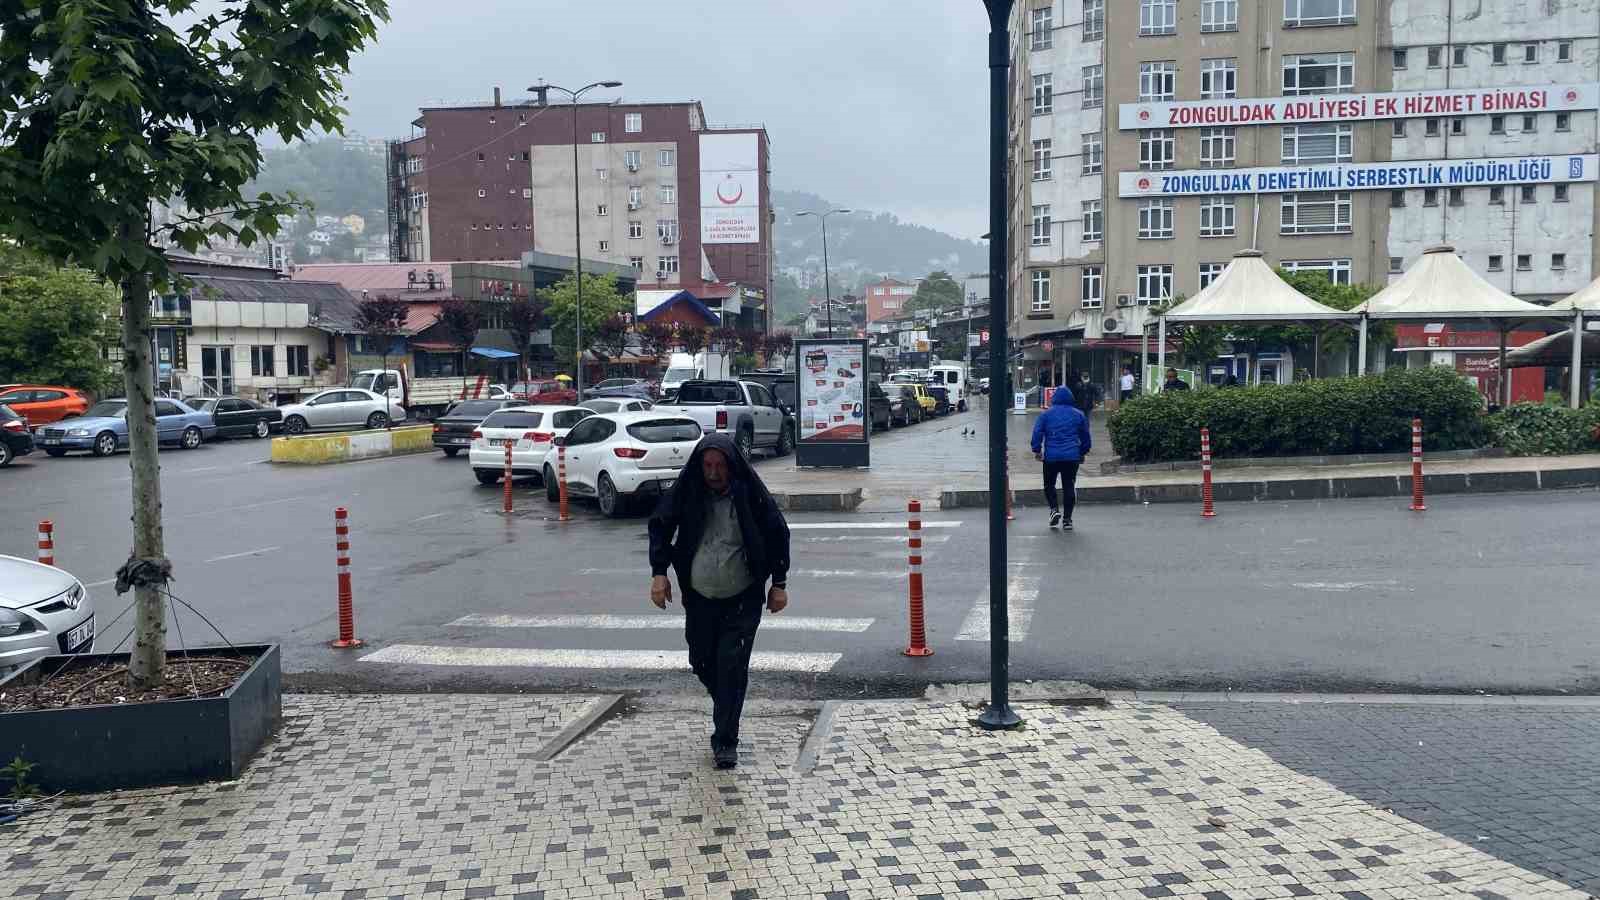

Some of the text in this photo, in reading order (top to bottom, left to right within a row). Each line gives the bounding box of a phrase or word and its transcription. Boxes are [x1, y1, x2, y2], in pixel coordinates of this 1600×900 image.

[1169, 88, 1547, 125] ZONGULDAK ADLİYESİ EK HİZMET BİNASI
[1162, 158, 1552, 193] ZONGULDAK DENETİMLİ SERBESTLİK MÜDÜRLÜĞÜ
